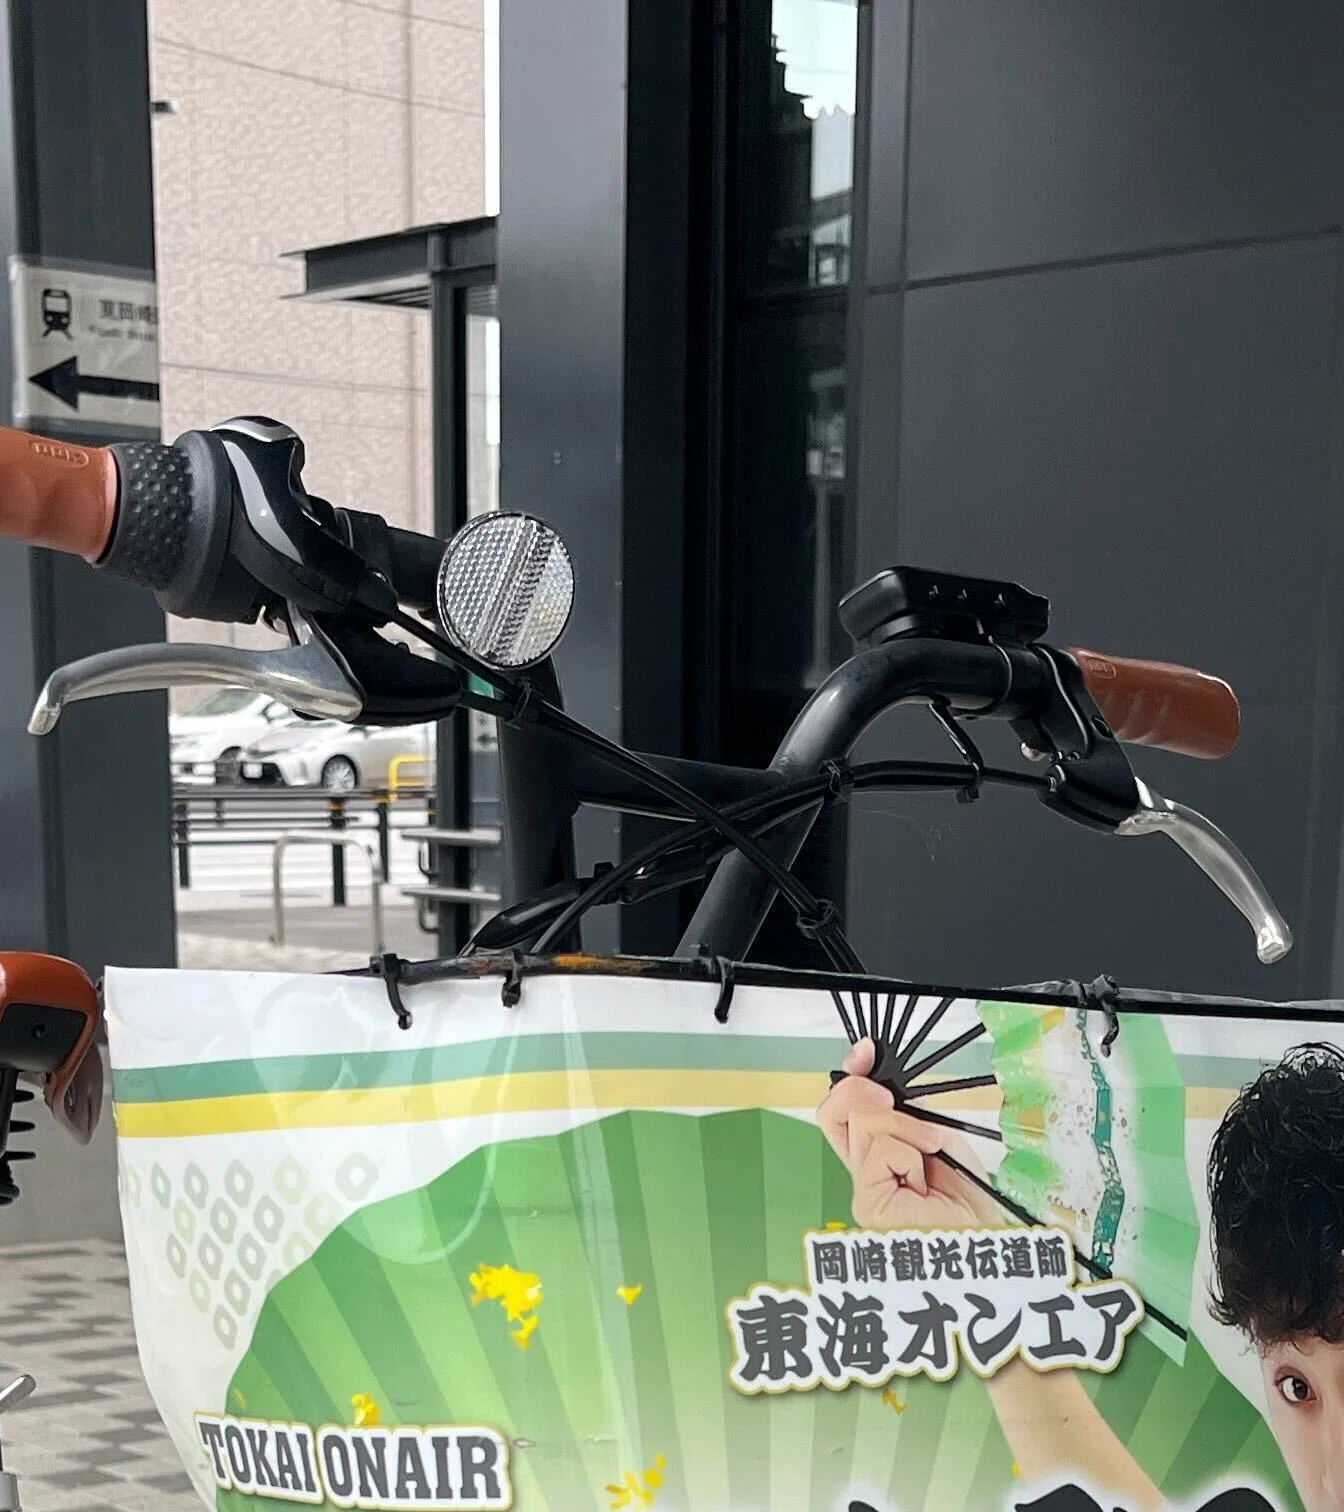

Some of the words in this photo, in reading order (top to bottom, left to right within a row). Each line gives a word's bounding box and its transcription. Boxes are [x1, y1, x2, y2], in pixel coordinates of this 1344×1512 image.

[813, 1235, 1067, 1284] 岡崎観光伝道師
[736, 1288, 1137, 1382] 東海オンエア
[200, 1421, 317, 1503] TOKAI
[322, 1433, 503, 1501] ONAIR
